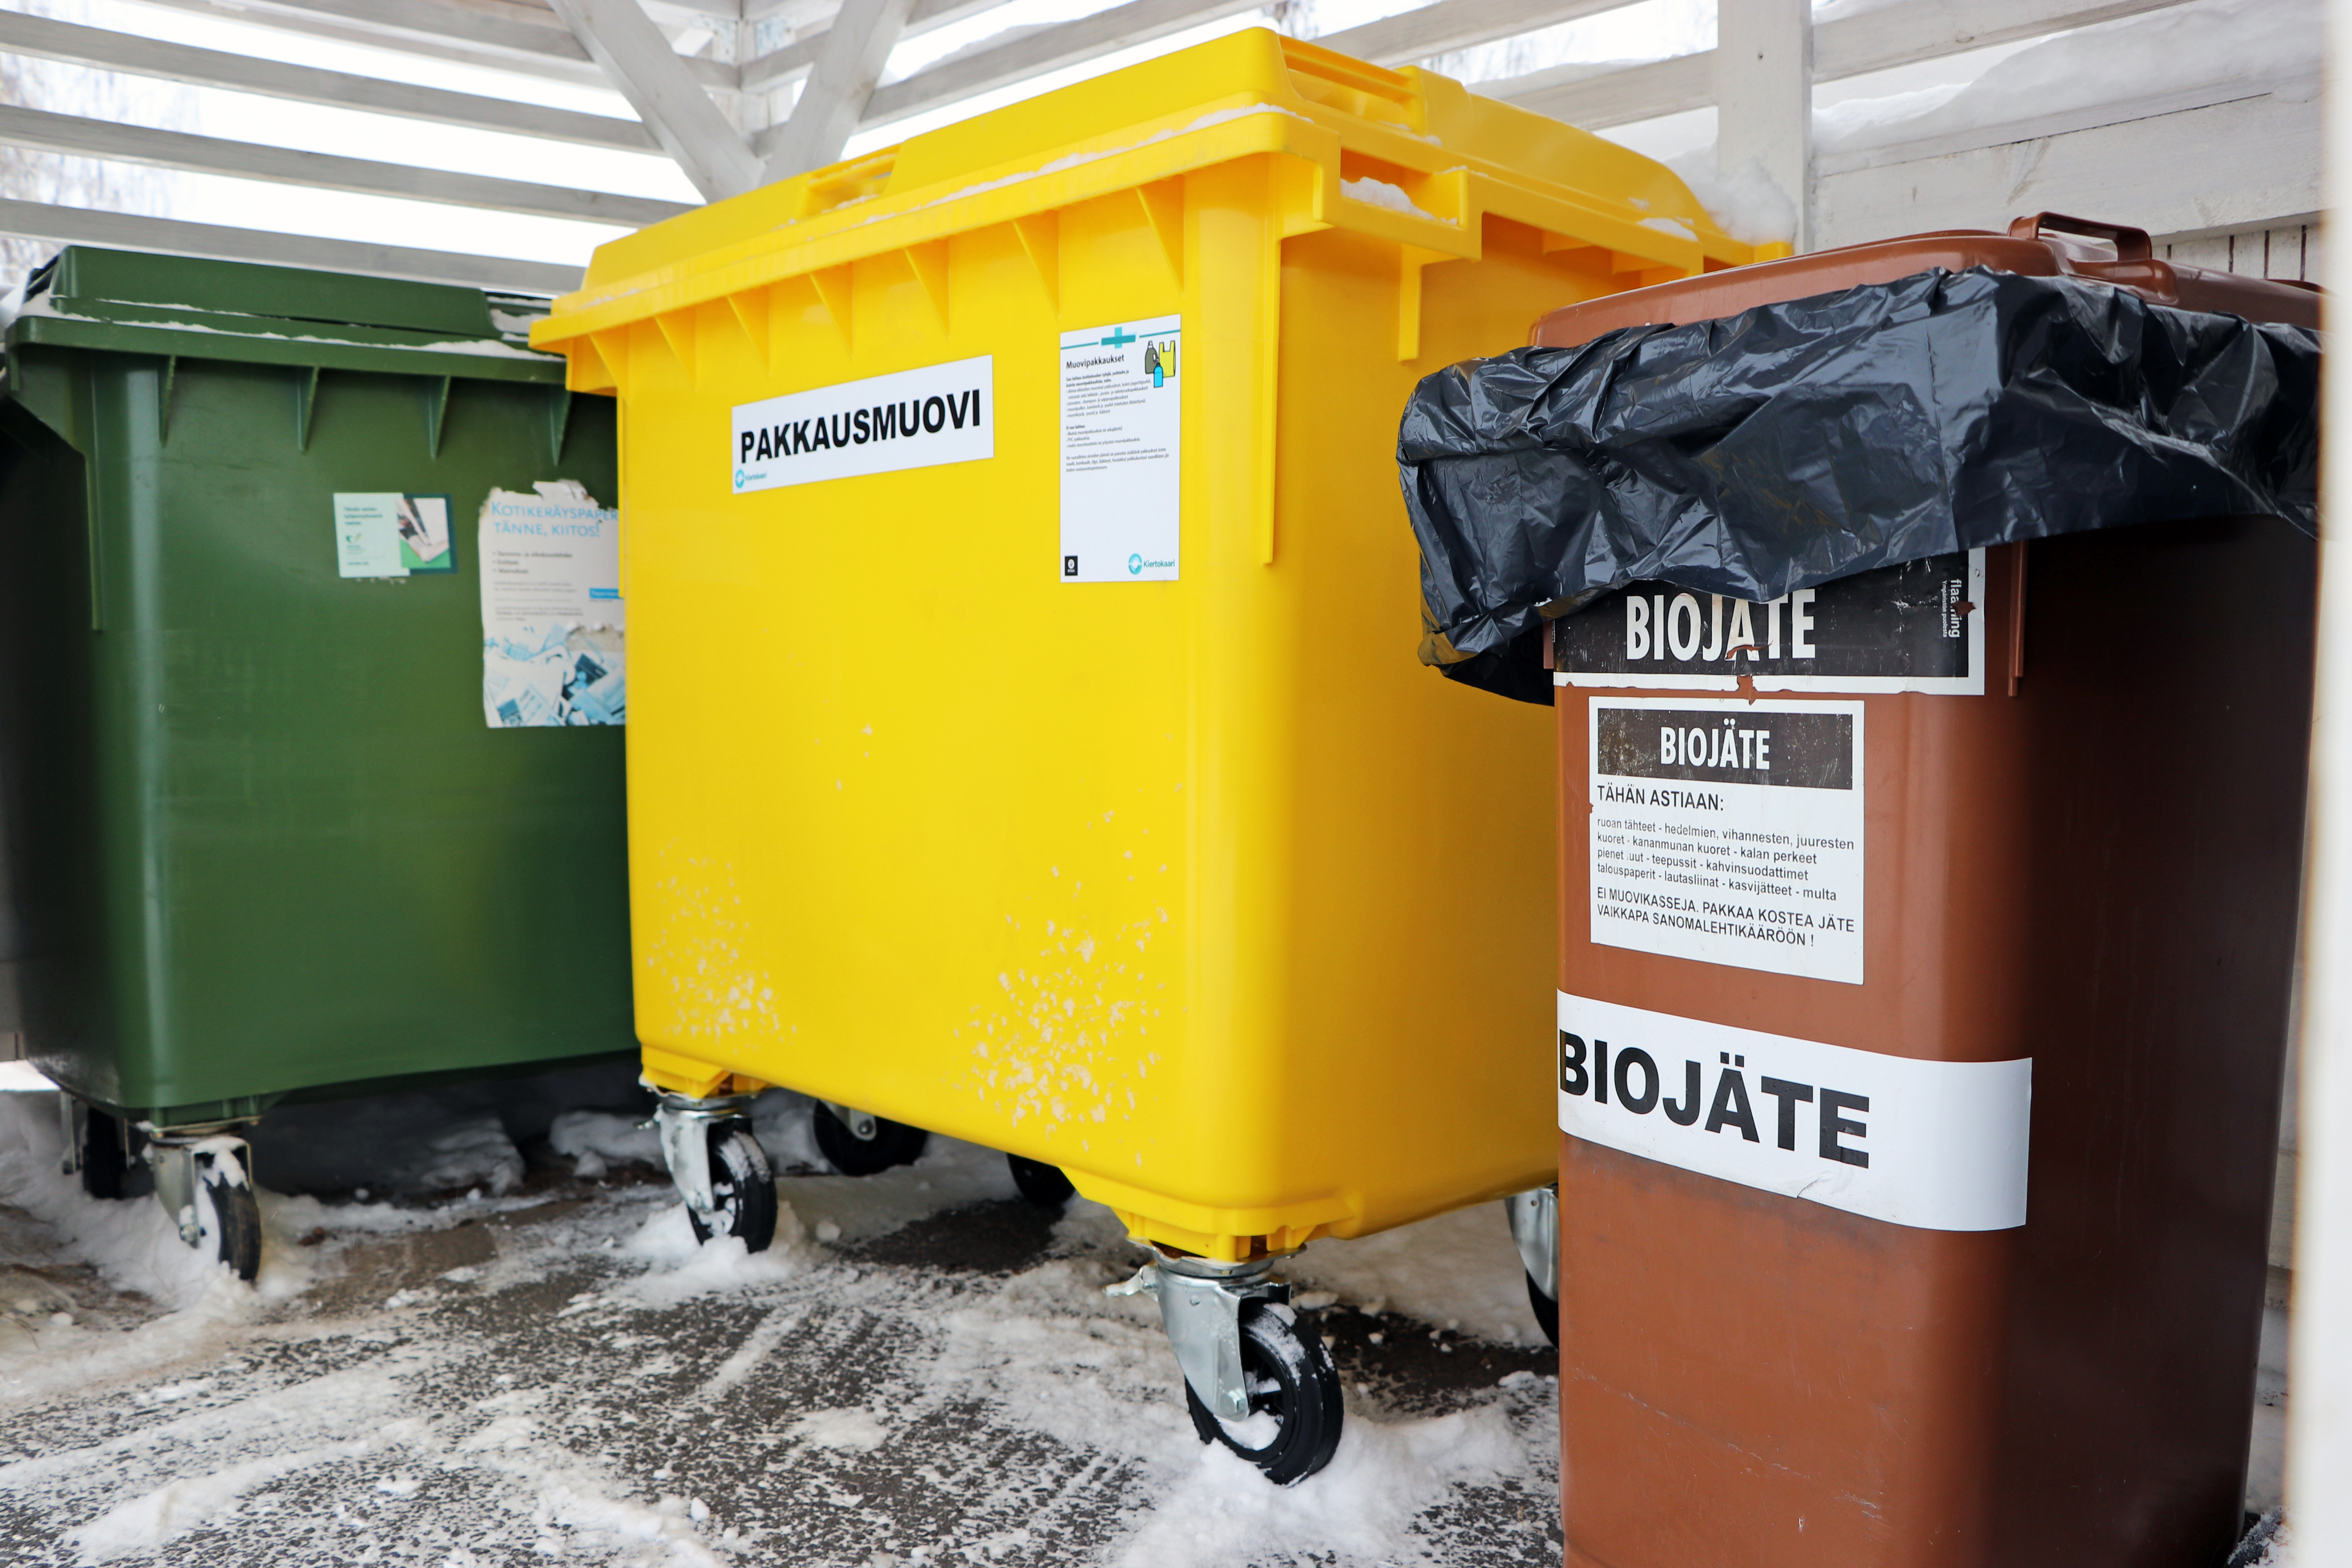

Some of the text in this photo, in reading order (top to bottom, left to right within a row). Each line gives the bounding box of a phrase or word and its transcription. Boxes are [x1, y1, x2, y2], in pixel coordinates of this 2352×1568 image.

[1066, 354, 1125, 369] Muovipakkaukset
[742, 389, 980, 464] PAKKAUSMUOVI
[494, 520, 600, 537] TÄNNE, KIITOS!
[1143, 559, 1175, 568] Kiertokaari
[1660, 718, 1771, 771] BIOJÄTE
[1597, 782, 1724, 812] TÄHÄN ASTIAAN:
[1597, 818, 1622, 829] ruoan
[1624, 819, 1656, 832] tähteet
[1665, 823, 1719, 840] hedelmien,
[1722, 829, 1793, 847] vihannesten,
[1796, 834, 1855, 850] juuresten
[1597, 832, 1625, 845] kuoret
[1633, 835, 1694, 853] kananmunan
[1698, 842, 1730, 856] kuoret
[1741, 846, 1770, 860] kalan
[1774, 851, 1817, 864] perkeet
[1598, 848, 1624, 861] pienet
[1652, 854, 1697, 869] teepussit
[1706, 858, 1808, 881] kahvinsuodattimet
[1597, 863, 1656, 880] talouspaperit
[1665, 870, 1719, 888] lautasliinat
[1729, 878, 1792, 896] kasvijätteet
[1803, 888, 1837, 901] multa
[1597, 886, 1855, 932] EI MUOVIKASSEJA. PAKKAA KOSTEA JÄTE
[1597, 903, 1649, 923] VAIKKAPA
[1653, 912, 1806, 946] SANOMALEHTIKÄÄRÖÖN
[1559, 1029, 1869, 1169] BIOJÄTE
